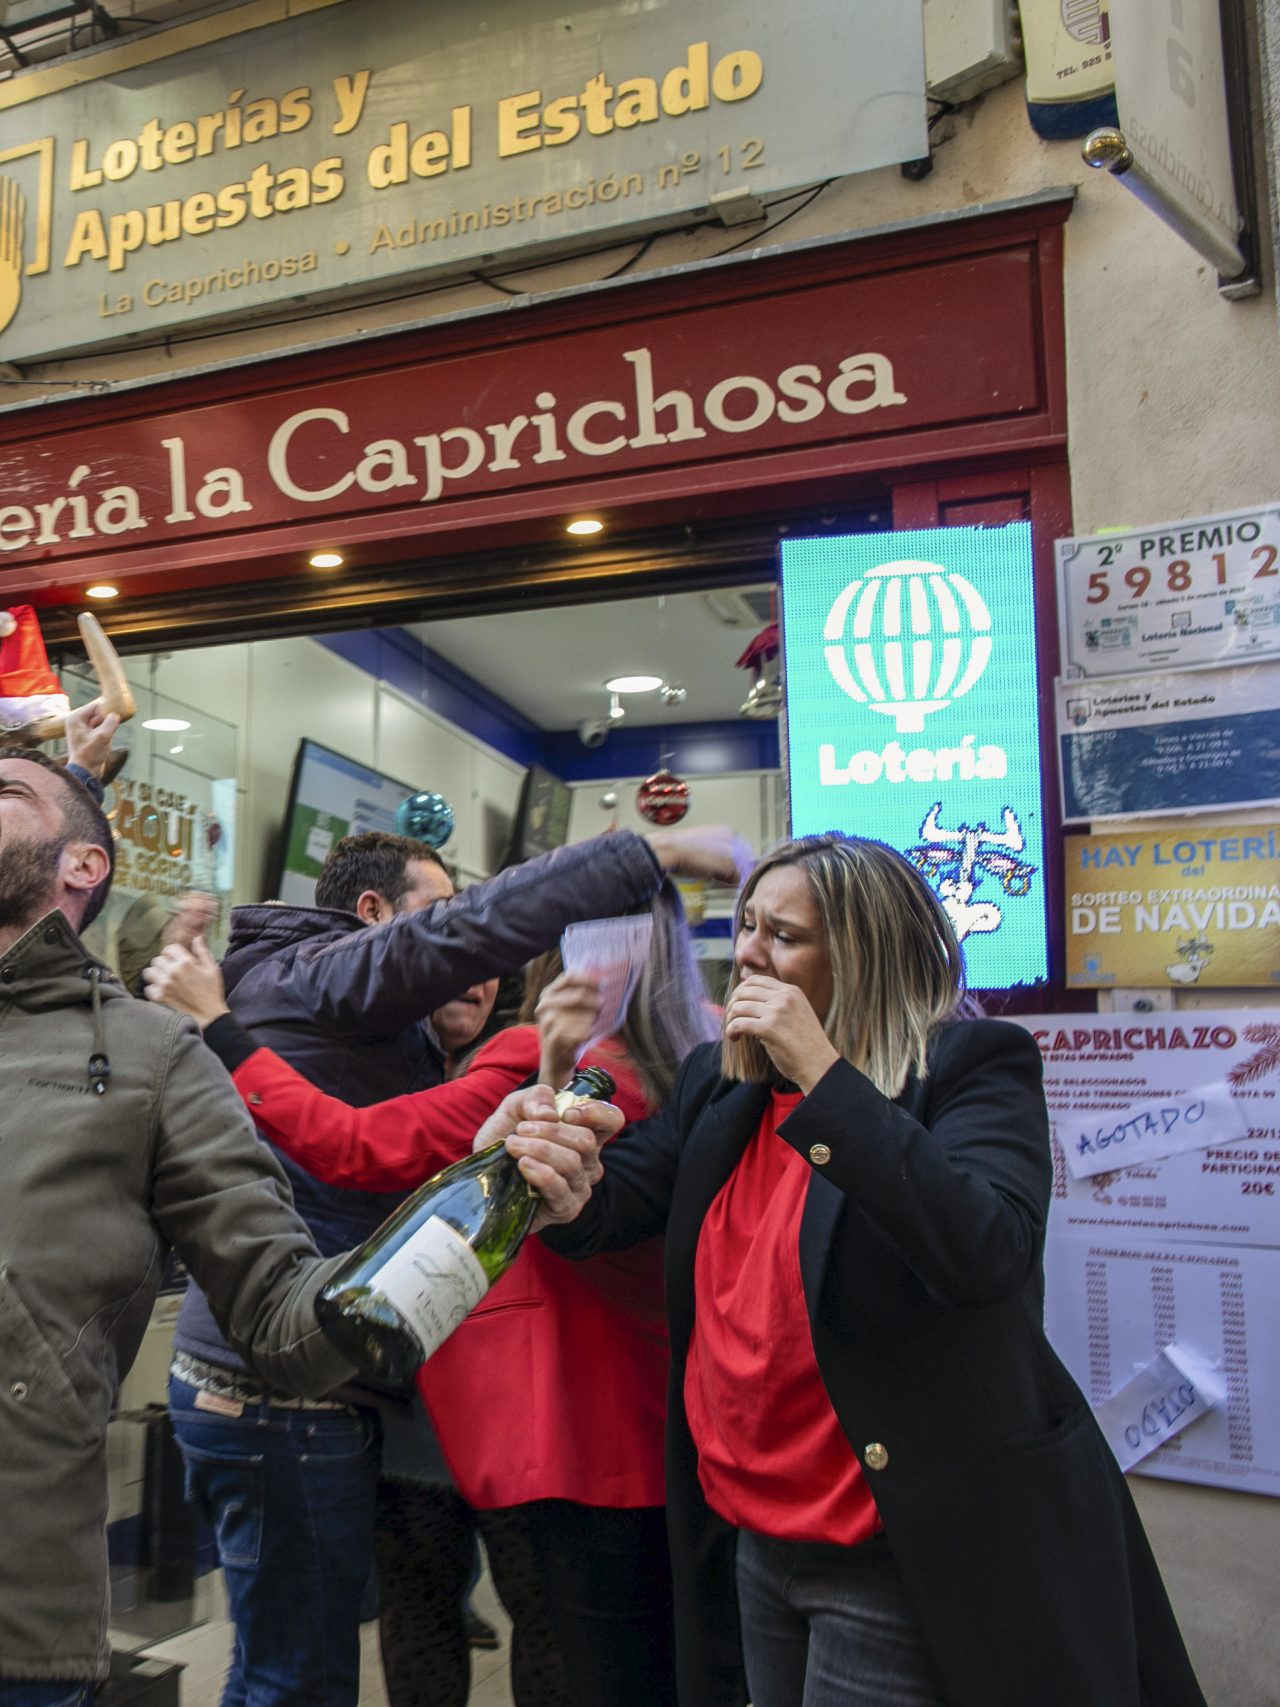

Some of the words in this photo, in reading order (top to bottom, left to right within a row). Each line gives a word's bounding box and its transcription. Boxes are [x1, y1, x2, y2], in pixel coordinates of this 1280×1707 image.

[69, 85, 312, 191] Loterías
[332, 68, 372, 135] y
[64, 155, 345, 272] Apuestas
[367, 104, 472, 190] del
[497, 41, 764, 158] Estado
[99, 292, 132, 318] La
[142, 250, 317, 307] Caprichosa
[368, 172, 643, 255] Administración
[716, 137, 765, 175] 12
[161, 437, 253, 524] la
[268, 347, 908, 502] Caprichosa
[1140, 521, 1262, 561] PREMIO
[1151, 700, 1170, 710] del
[1173, 694, 1216, 707] Estado
[818, 735, 1008, 786] Lotería
[1080, 843, 1144, 870] HAY
[1153, 829, 1280, 866] LOTERÍ
[1181, 865, 1205, 877] del
[1071, 889, 1143, 907] SORTEO
[1072, 906, 1122, 935] DE
[1135, 900, 1280, 934] NAVIDA
[1033, 1025, 1237, 1051] CAPRICHAZO
[1076, 1099, 1205, 1157] AGOTADO
[1206, 1150, 1258, 1161] PRECIO
[1241, 1181, 1275, 1196] 20€
